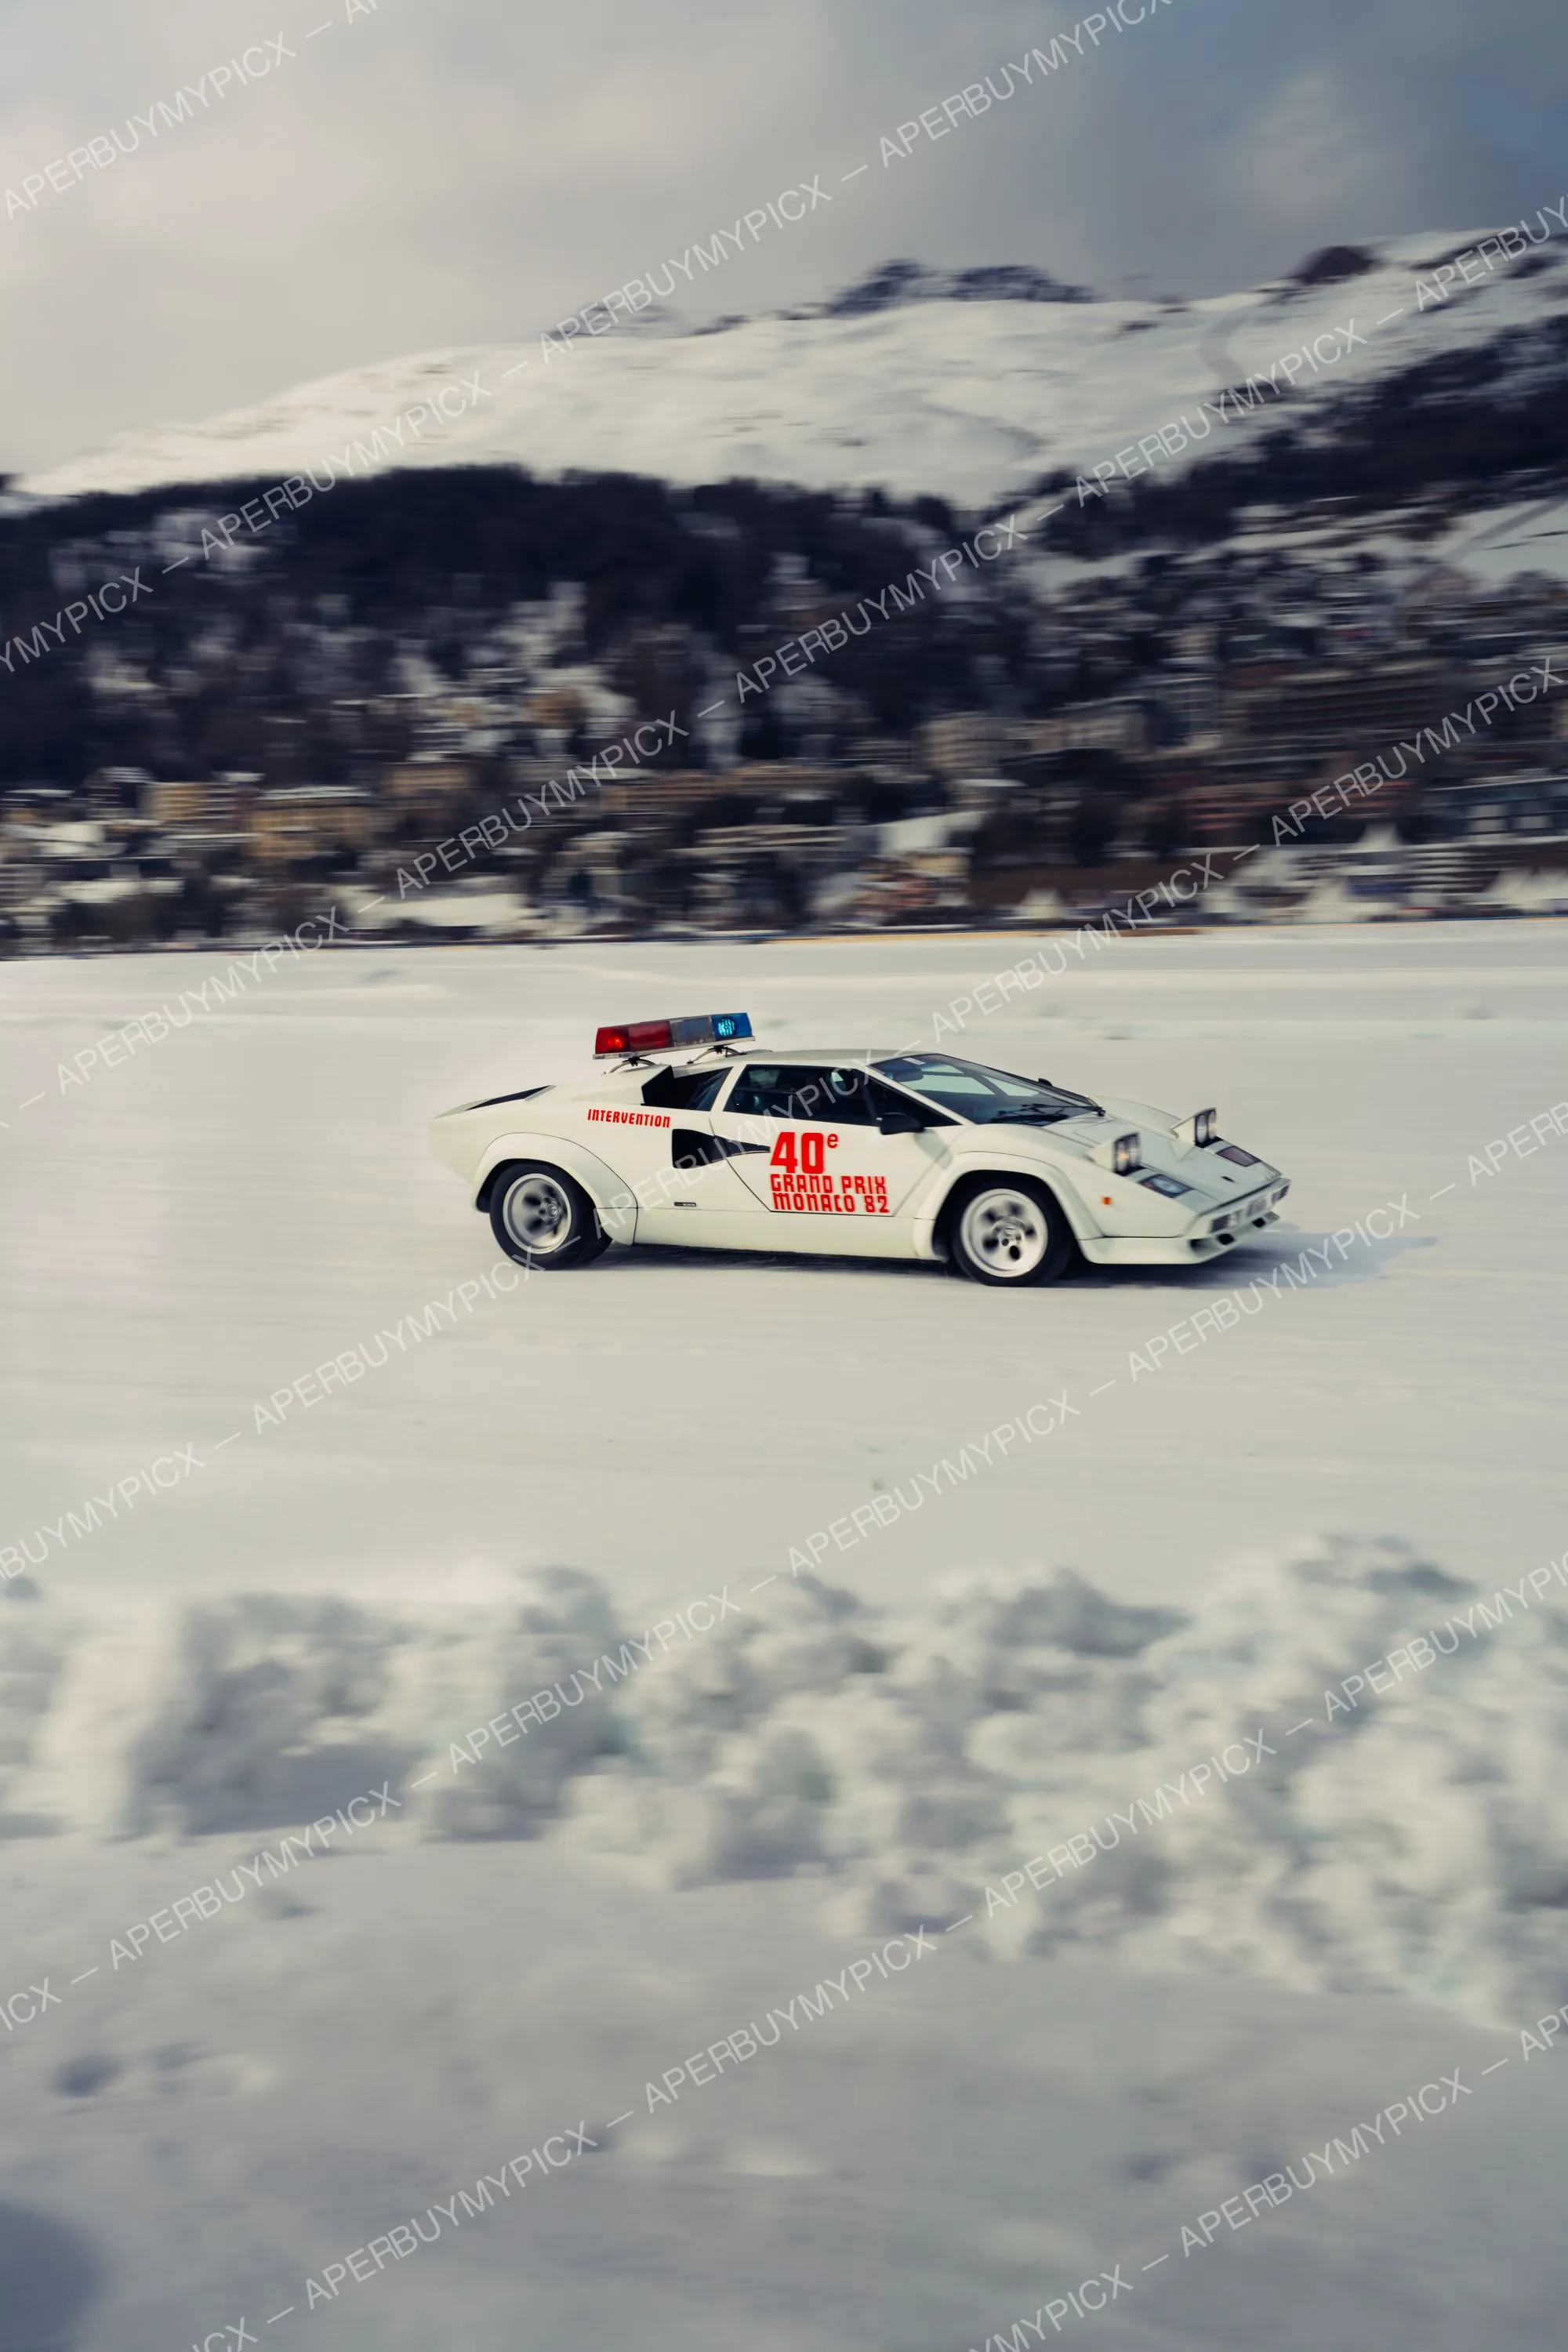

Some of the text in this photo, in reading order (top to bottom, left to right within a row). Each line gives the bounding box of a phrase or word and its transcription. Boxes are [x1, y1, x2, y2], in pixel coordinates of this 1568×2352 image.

[587, 1109, 671, 1128] INTERVENTION
[770, 1174, 887, 1194] GRAND PRIX
[772, 1192, 889, 1213] MONACO 82
